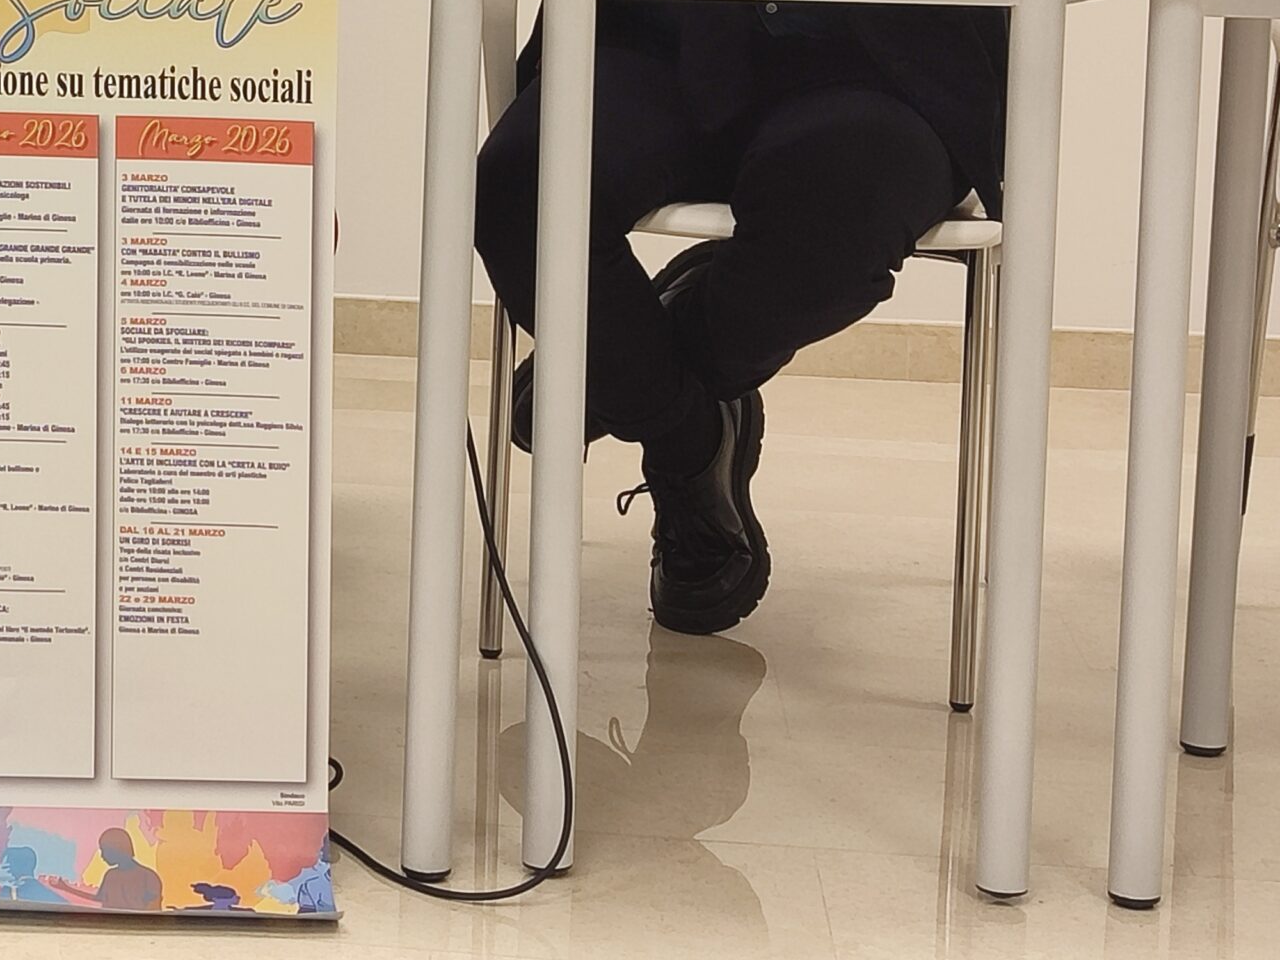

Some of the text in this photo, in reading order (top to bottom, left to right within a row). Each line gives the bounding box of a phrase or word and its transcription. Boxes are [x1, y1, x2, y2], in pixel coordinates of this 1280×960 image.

[56, 72, 84, 98] su
[93, 65, 222, 101] tematiche
[229, 68, 312, 104] sociali
[19, 119, 88, 149] 2026
[138, 120, 291, 159] Marzo 2026
[131, 174, 168, 182] MARZO
[130, 279, 167, 287] MARZO
[130, 318, 167, 326] MARZO
[130, 367, 166, 375] MARZO
[121, 397, 172, 405] 11 MARZO
[160, 448, 196, 456] MARZO
[120, 526, 139, 534] DAL
[173, 528, 185, 536] 21
[189, 529, 225, 537] MARZO
[159, 596, 195, 604] MARZO
